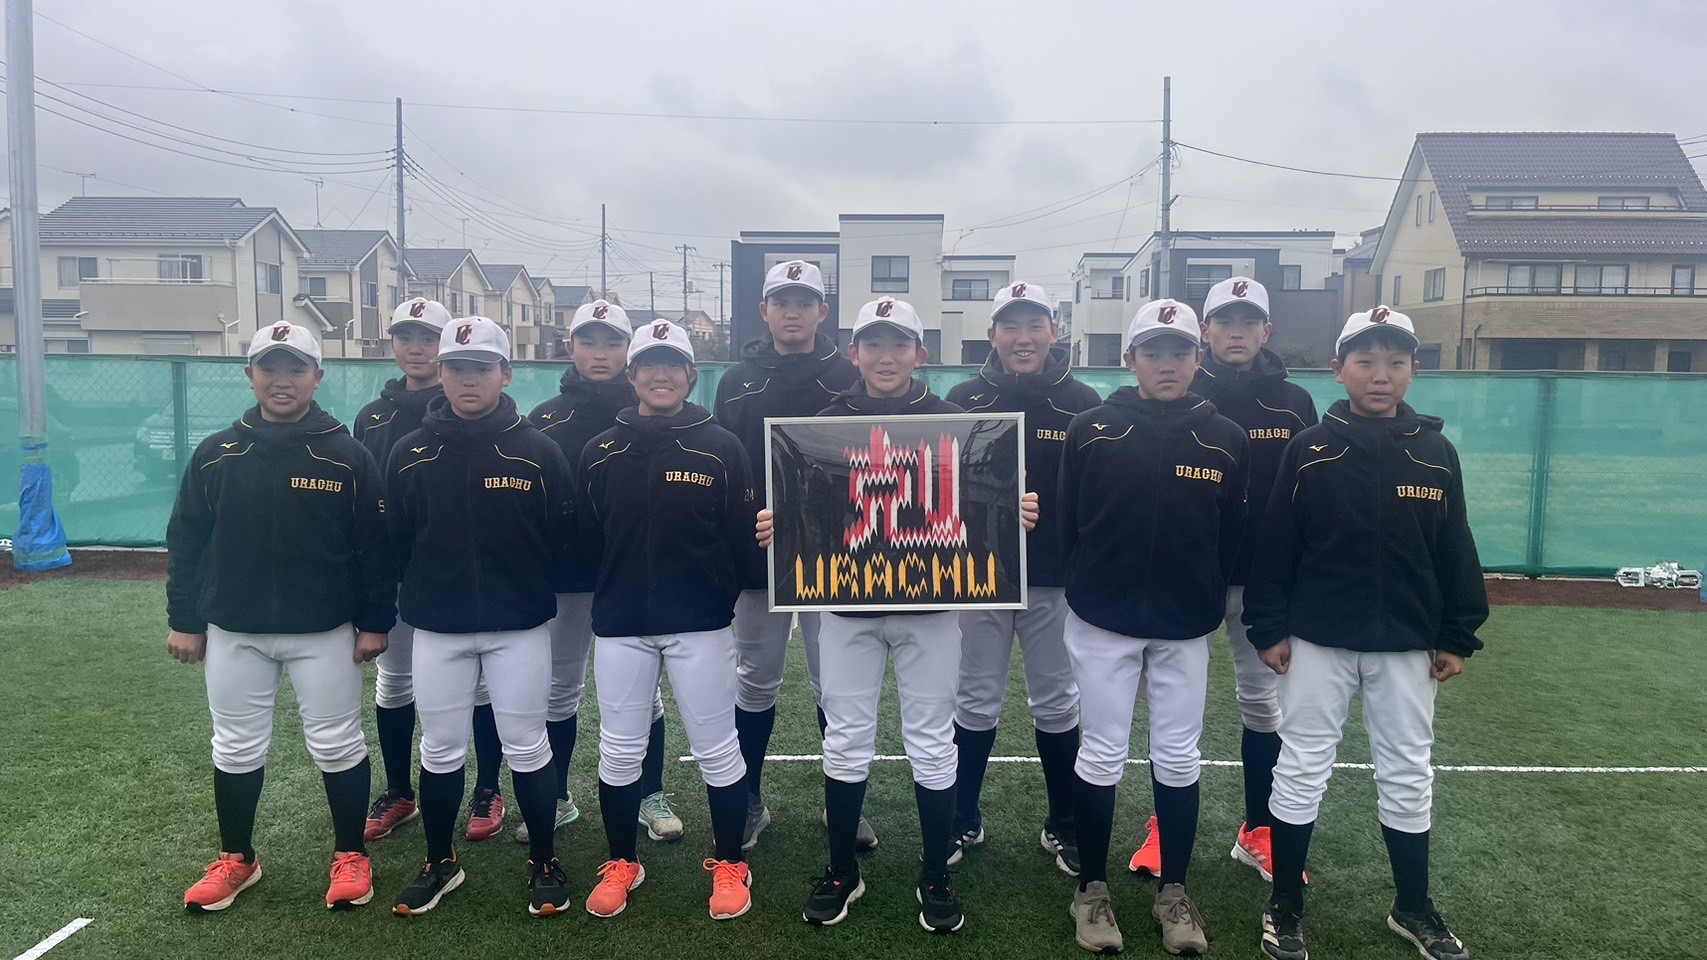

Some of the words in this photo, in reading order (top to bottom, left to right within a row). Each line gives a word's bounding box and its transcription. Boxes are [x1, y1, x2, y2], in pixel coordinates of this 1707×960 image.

[290, 477, 343, 493] URACHU
[484, 476, 532, 491] URACHU
[664, 470, 715, 487] URACHU
